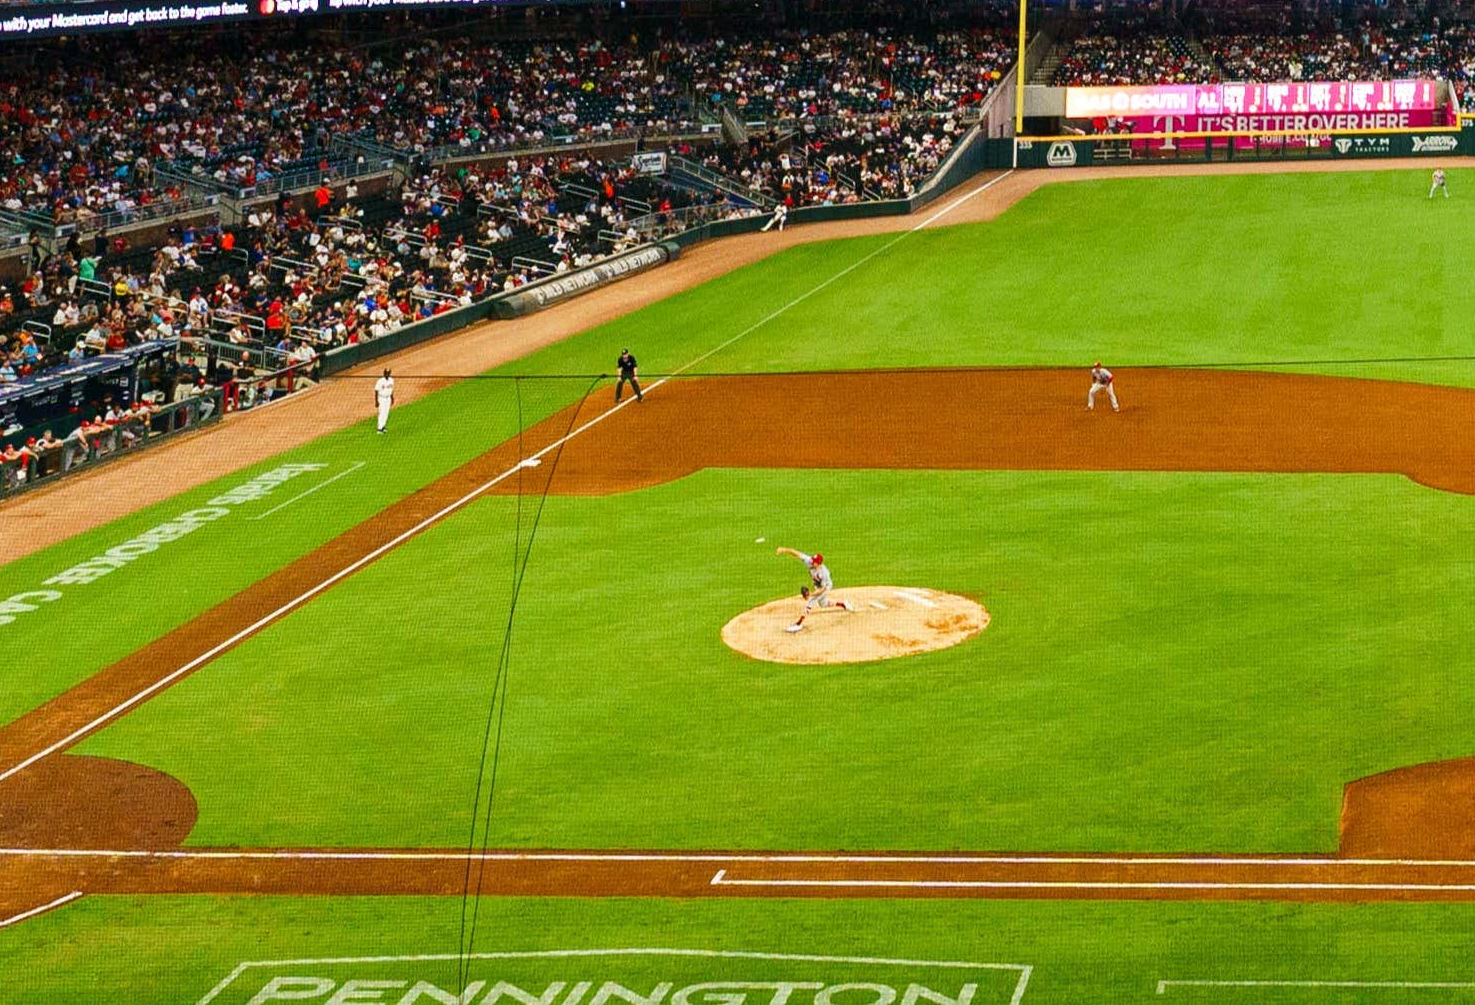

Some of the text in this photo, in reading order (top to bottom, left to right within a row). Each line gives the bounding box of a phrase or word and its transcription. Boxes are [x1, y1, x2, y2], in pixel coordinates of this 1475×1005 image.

[3, 16, 26, 32] with
[27, 16, 50, 33] your
[52, 9, 108, 28] Mastercard
[109, 9, 127, 24] and
[128, 8, 144, 25] get
[145, 6, 167, 21] back
[196, 6, 221, 20] game
[1198, 113, 1409, 133] IT'S BETTER OVER HERE
[43, 507, 230, 586] CHEROKEE
[241, 976, 978, 1005] PENNINGTON
